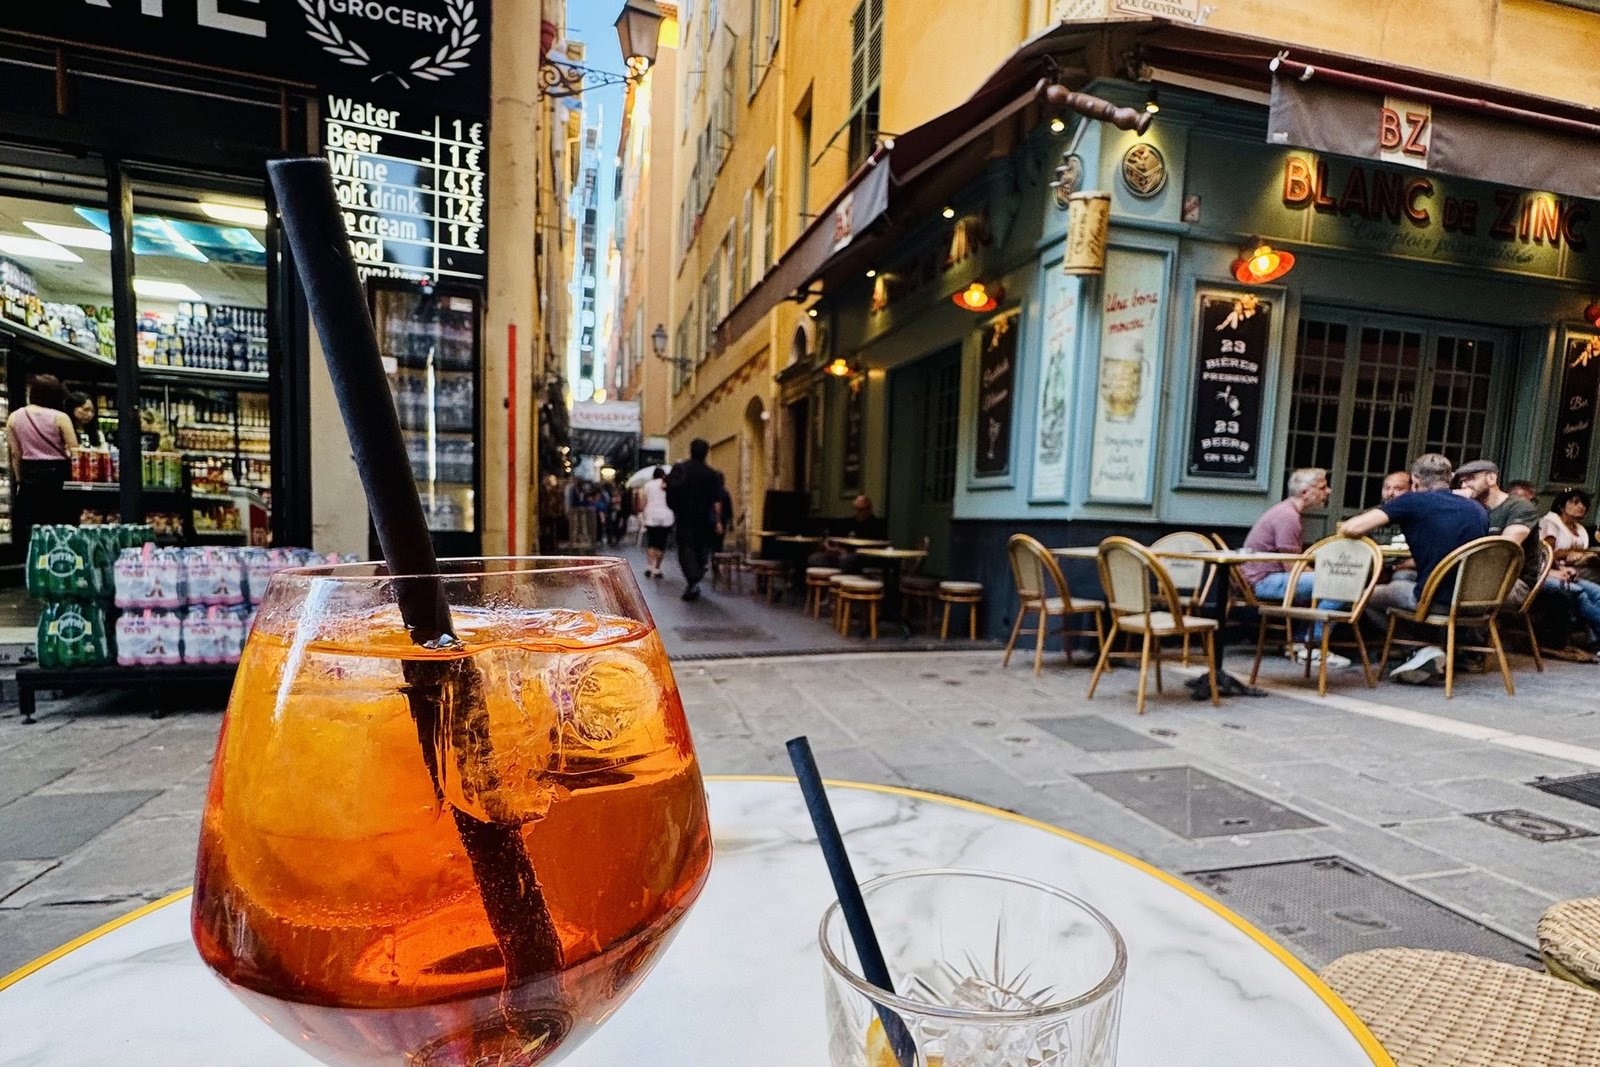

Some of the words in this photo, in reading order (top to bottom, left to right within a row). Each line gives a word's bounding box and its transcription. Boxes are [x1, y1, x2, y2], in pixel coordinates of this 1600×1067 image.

[329, 0, 449, 35] GROCERY
[328, 94, 400, 129] Water
[452, 119, 462, 141] 1
[469, 122, 483, 145] €
[1379, 107, 1429, 156] BZ
[327, 122, 383, 153] Beer
[449, 145, 460, 168] 1
[466, 148, 481, 171] €
[328, 150, 389, 182] Wine
[370, 184, 419, 214] drink
[1284, 157, 1433, 226] BLANC
[1443, 199, 1478, 234] DE
[1491, 189, 1591, 251] ZINC
[359, 214, 417, 240] cream
[448, 223, 460, 246] 1
[464, 226, 480, 249] €
[1221, 339, 1246, 354] 23
[1214, 420, 1239, 434] 23
[1201, 436, 1250, 452] BEERS
[1203, 453, 1221, 462] ON
[1222, 453, 1245, 464] TAP
